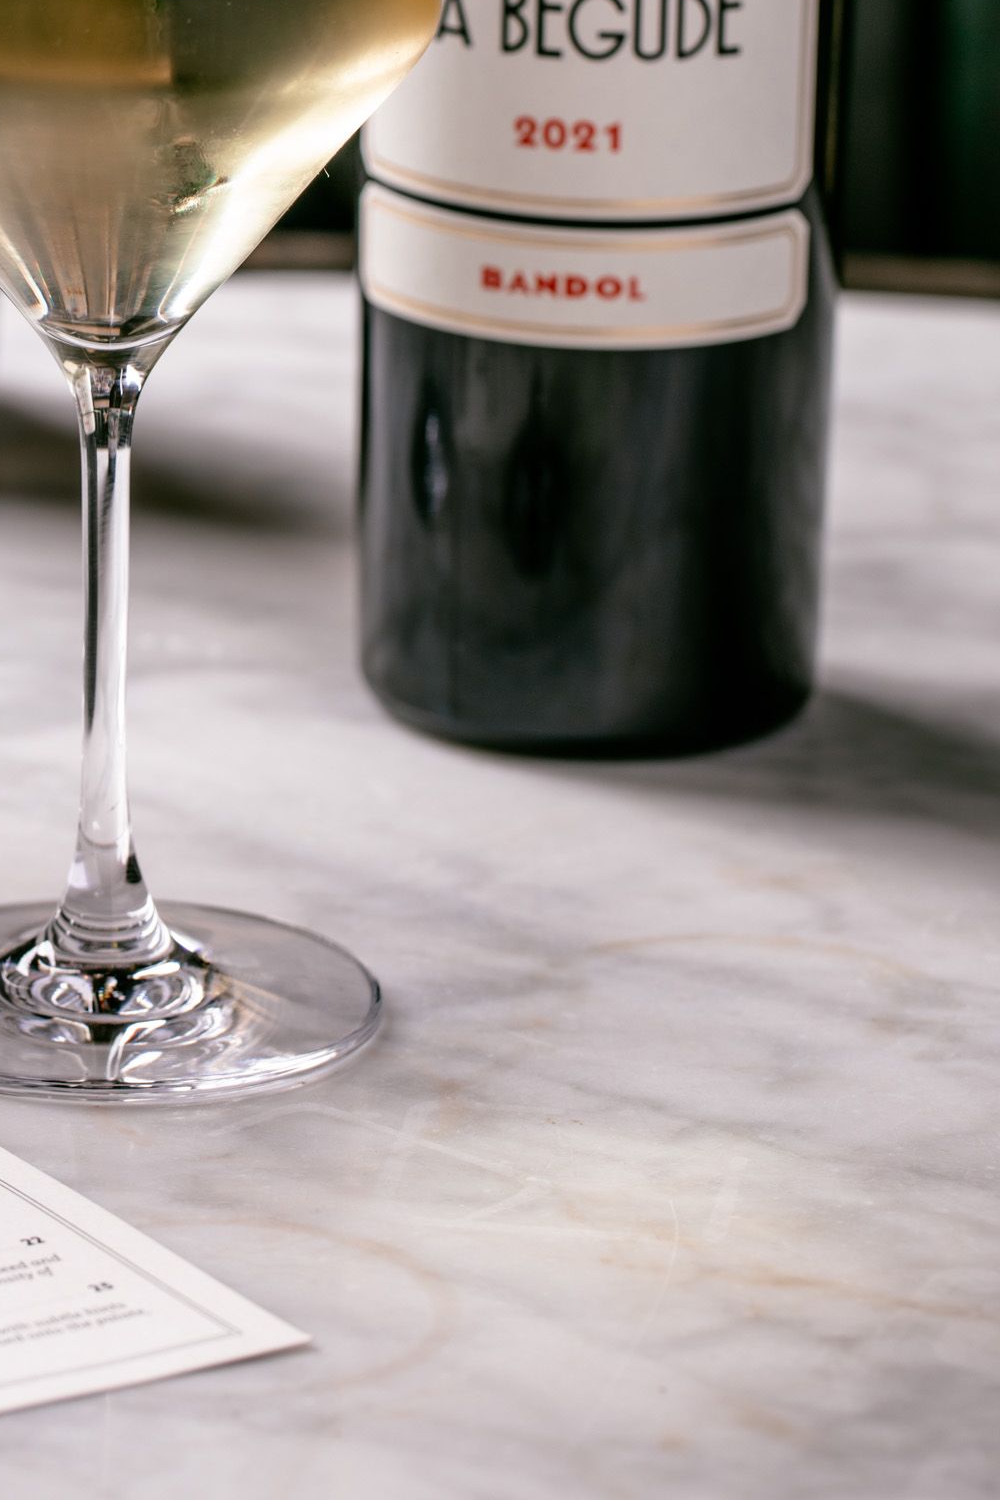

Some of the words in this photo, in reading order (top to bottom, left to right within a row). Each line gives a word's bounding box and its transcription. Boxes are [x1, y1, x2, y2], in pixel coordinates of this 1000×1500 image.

[513, 115, 623, 153] 2021
[480, 265, 646, 302] BANDOL
[20, 1236, 45, 1247] 22
